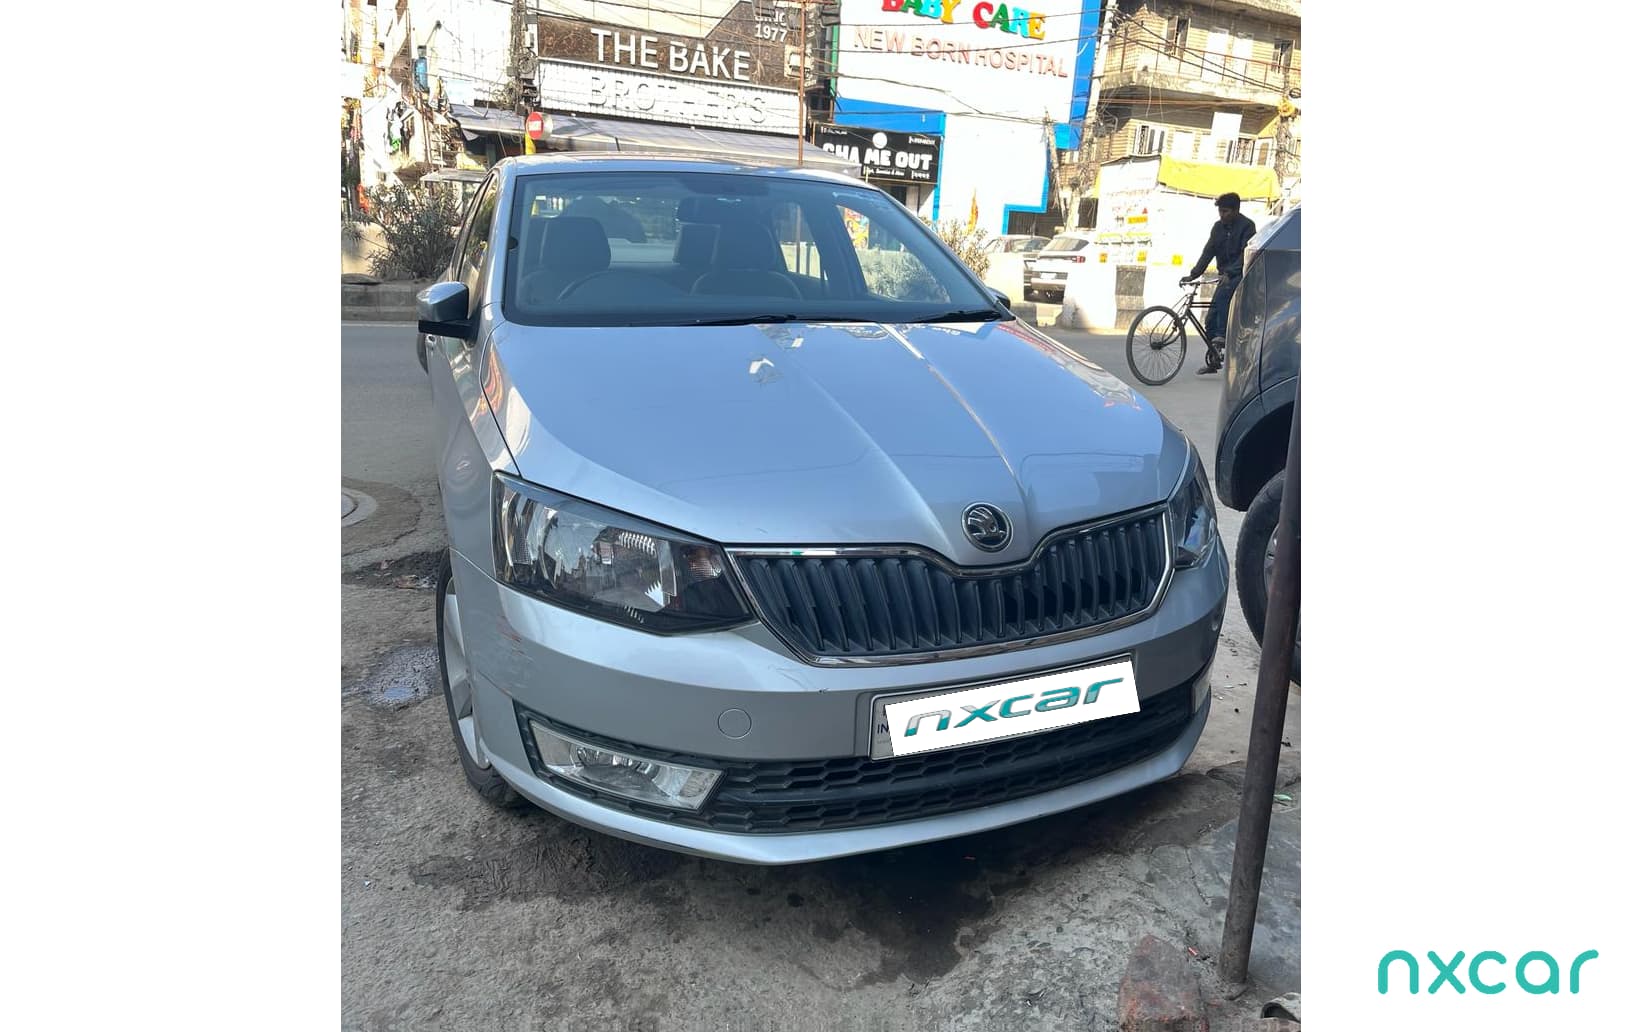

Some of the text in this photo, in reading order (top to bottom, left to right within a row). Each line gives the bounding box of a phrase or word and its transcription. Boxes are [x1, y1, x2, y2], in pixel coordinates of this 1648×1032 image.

[755, 23, 788, 42] 1977
[972, 1, 1046, 40] CARE
[590, 27, 751, 81] THE BAKE
[854, 27, 1068, 78] NEW BORN HOSPITAL
[863, 147, 892, 167] ME
[895, 151, 933, 171] OUT
[877, 721, 890, 735] IN
